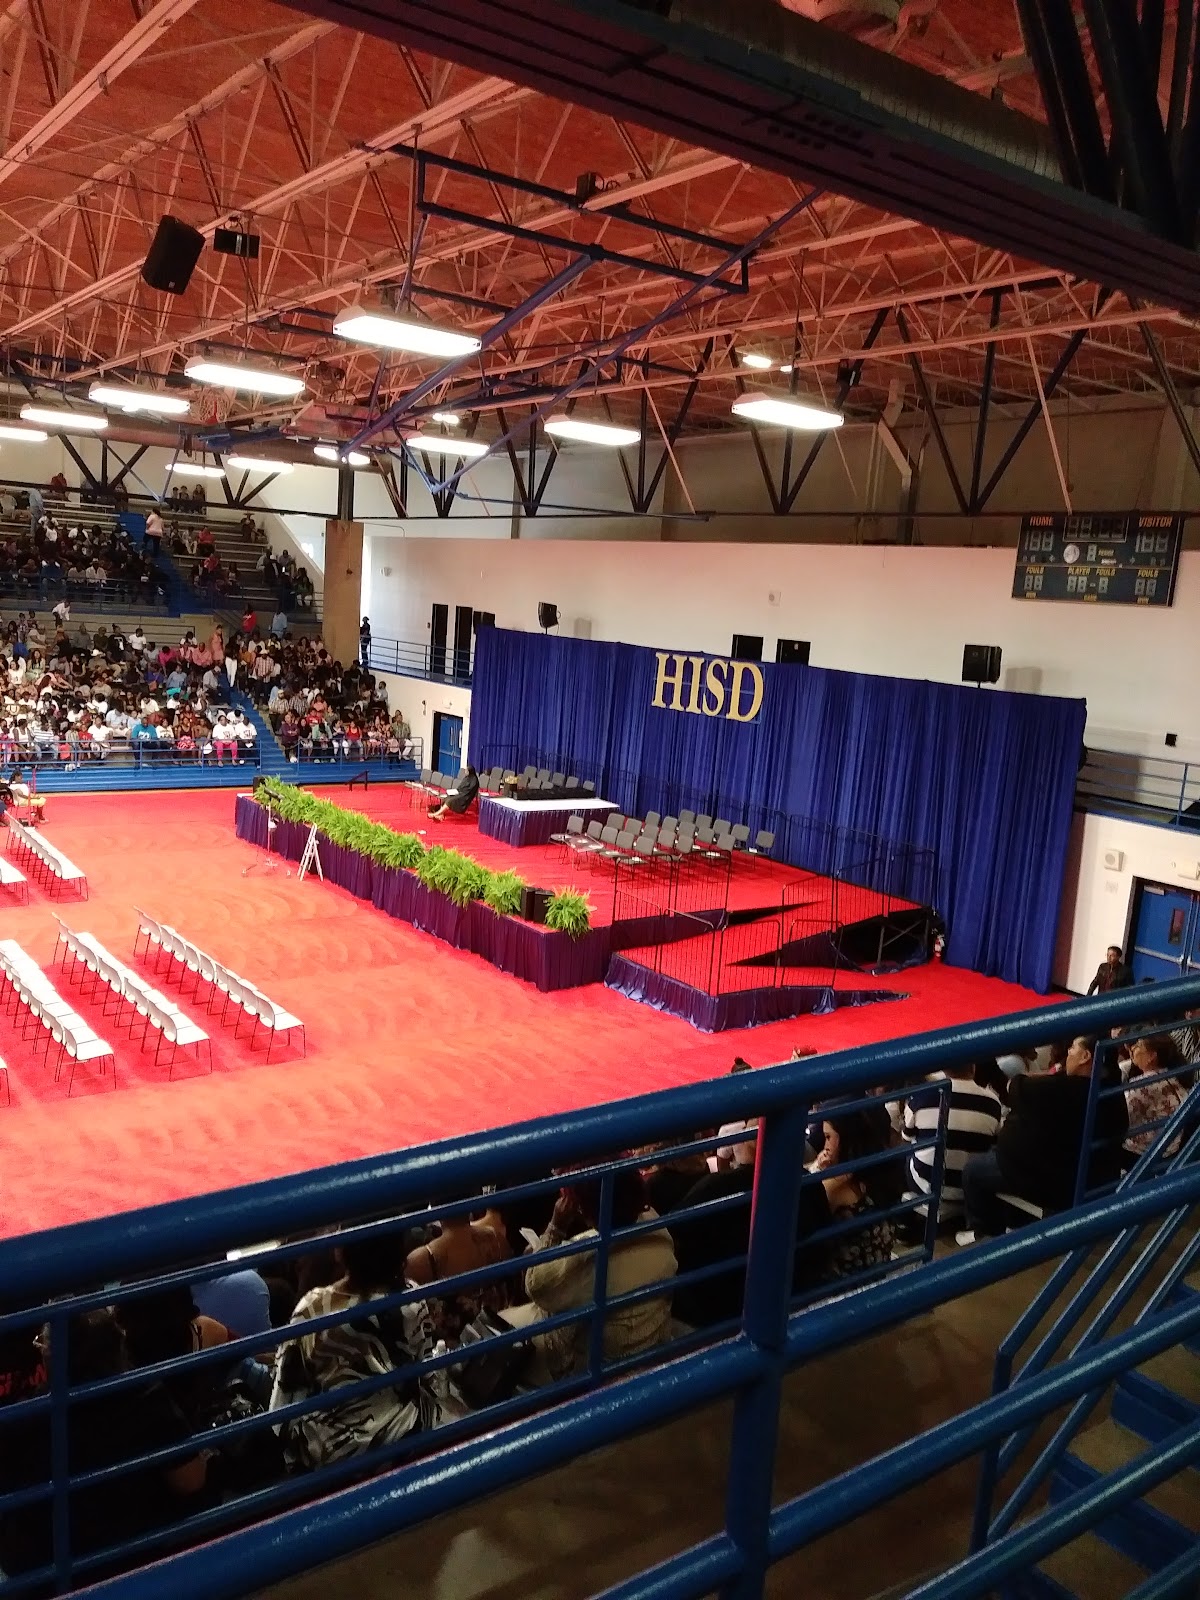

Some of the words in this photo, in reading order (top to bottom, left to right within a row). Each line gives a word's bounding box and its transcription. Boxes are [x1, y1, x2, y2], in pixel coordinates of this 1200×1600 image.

[1029, 516, 1054, 527] HOME
[1139, 516, 1173, 528] VISITOR
[651, 651, 764, 723] HISD
